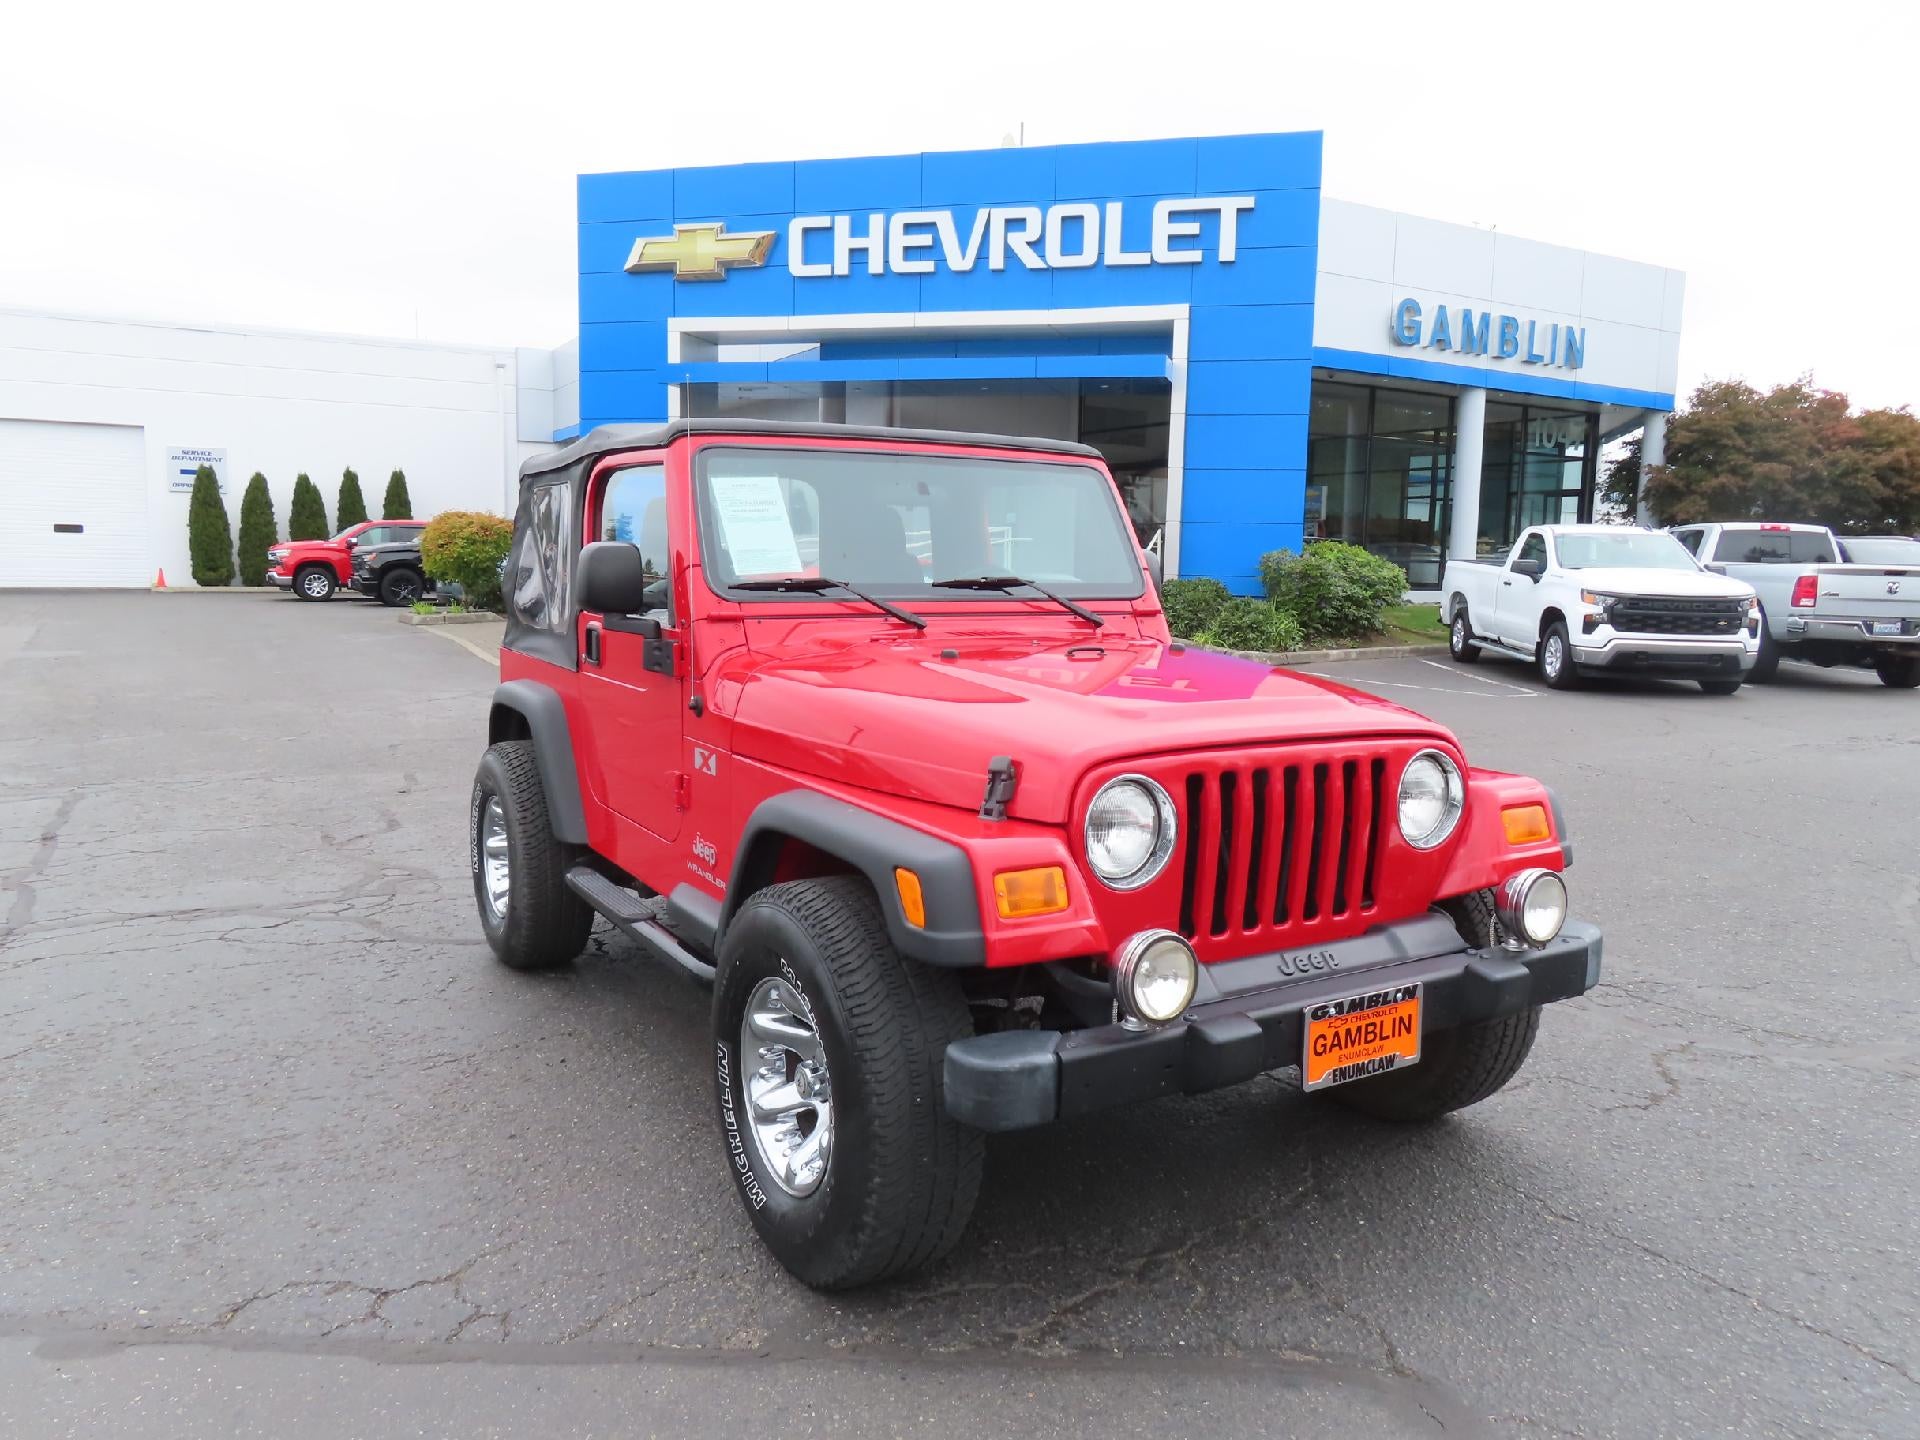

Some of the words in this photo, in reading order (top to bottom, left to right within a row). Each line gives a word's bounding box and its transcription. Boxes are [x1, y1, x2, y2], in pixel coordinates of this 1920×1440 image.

[788, 196, 1255, 277] CHEVROLET
[1393, 297, 1586, 370] GAMBLIN
[692, 832, 717, 866] Jeep
[686, 860, 726, 890] WRANGLER
[1278, 950, 1341, 976] Jeep
[1310, 984, 1418, 1021] GAMBLIN
[1350, 1007, 1398, 1023] CHEVROLET
[1313, 1014, 1413, 1056] GAMBLIN
[1332, 1054, 1395, 1083] ENUMCLAW
[1338, 1045, 1385, 1062] ENUMCLAW
[717, 1041, 766, 1210] MICHELIN
